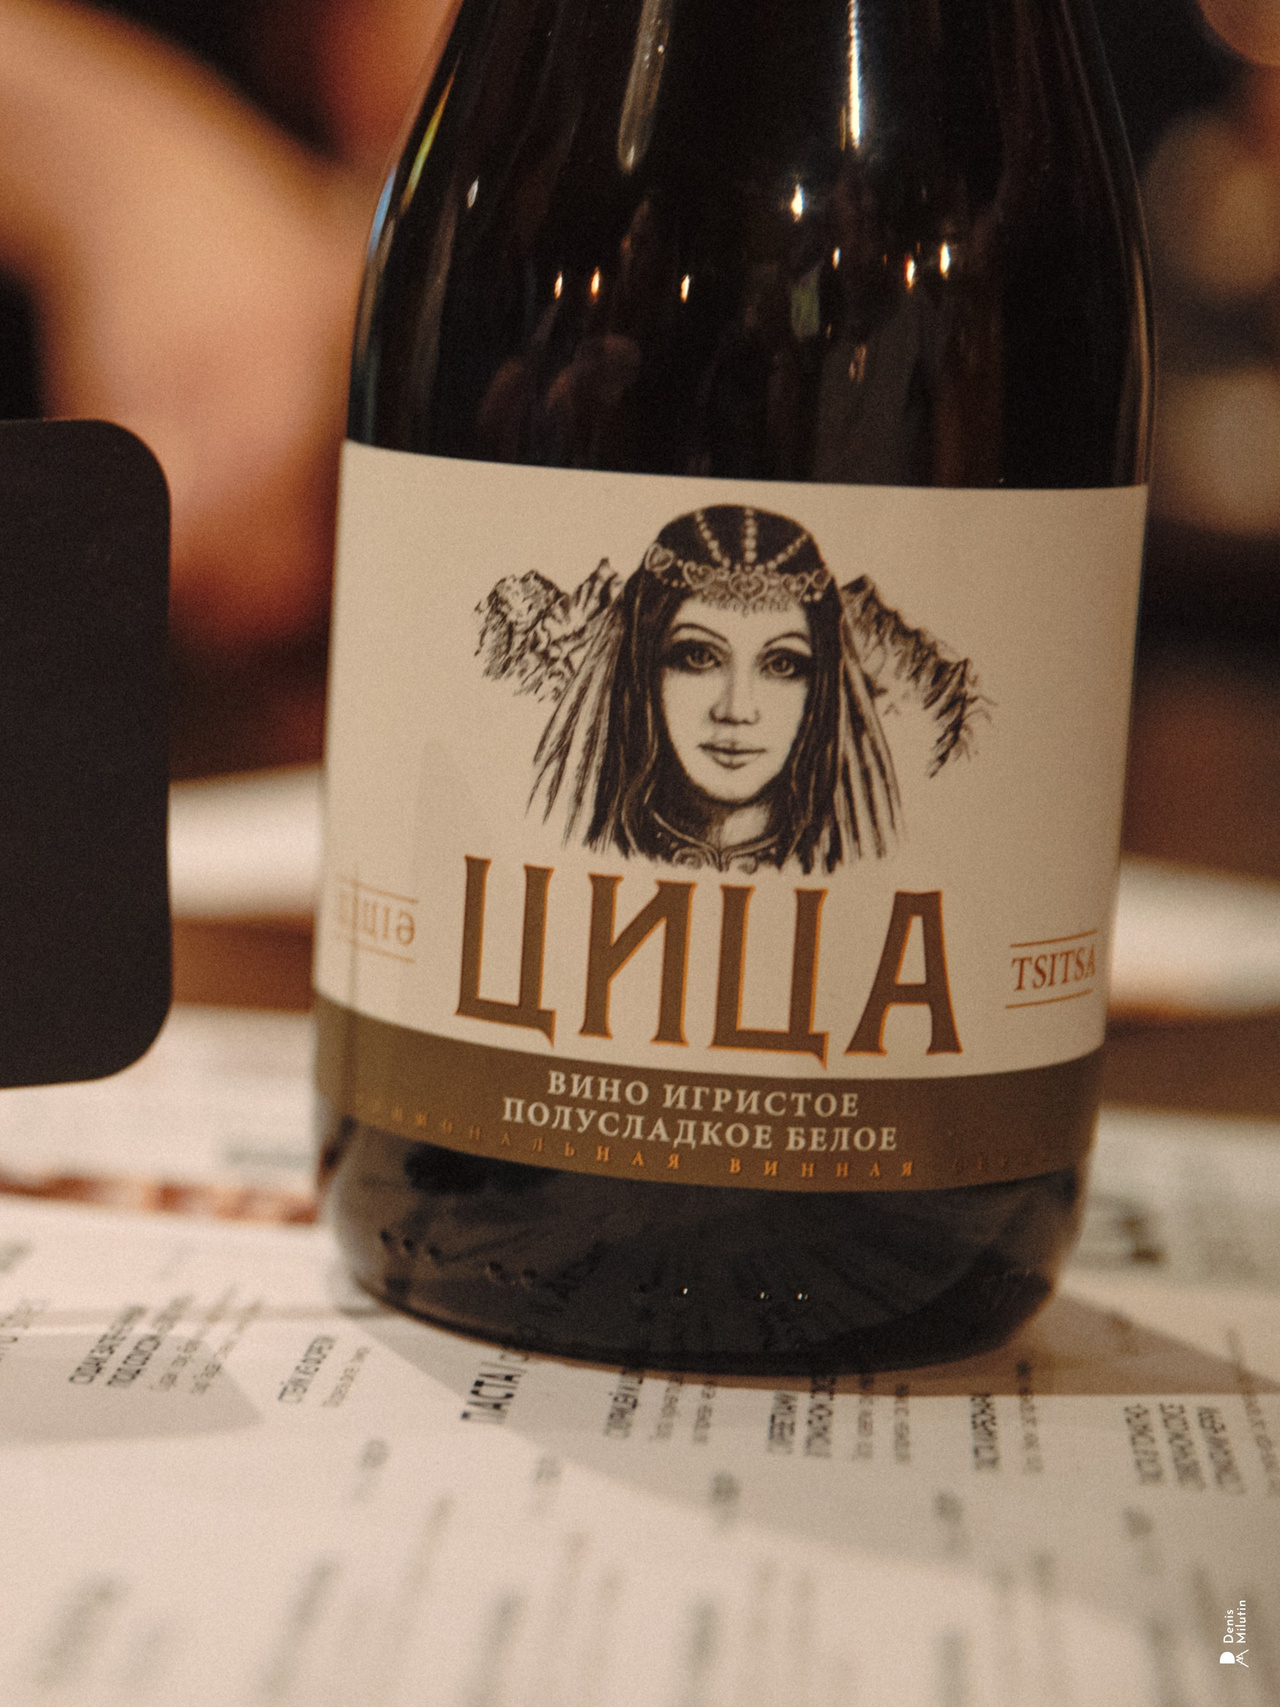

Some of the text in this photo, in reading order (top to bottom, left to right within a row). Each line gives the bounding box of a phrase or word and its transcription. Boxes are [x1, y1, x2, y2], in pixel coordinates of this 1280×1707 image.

[454, 855, 963, 1071] ЦИЦА
[1010, 943, 1097, 992] TSITSA
[547, 1069, 859, 1119] ВИНО ИГРИСТОЕ
[502, 1096, 898, 1153] ПОЛУСЛАДКОЕ БЕЛОЕ
[729, 1157, 913, 1178] ВИННАЯ
